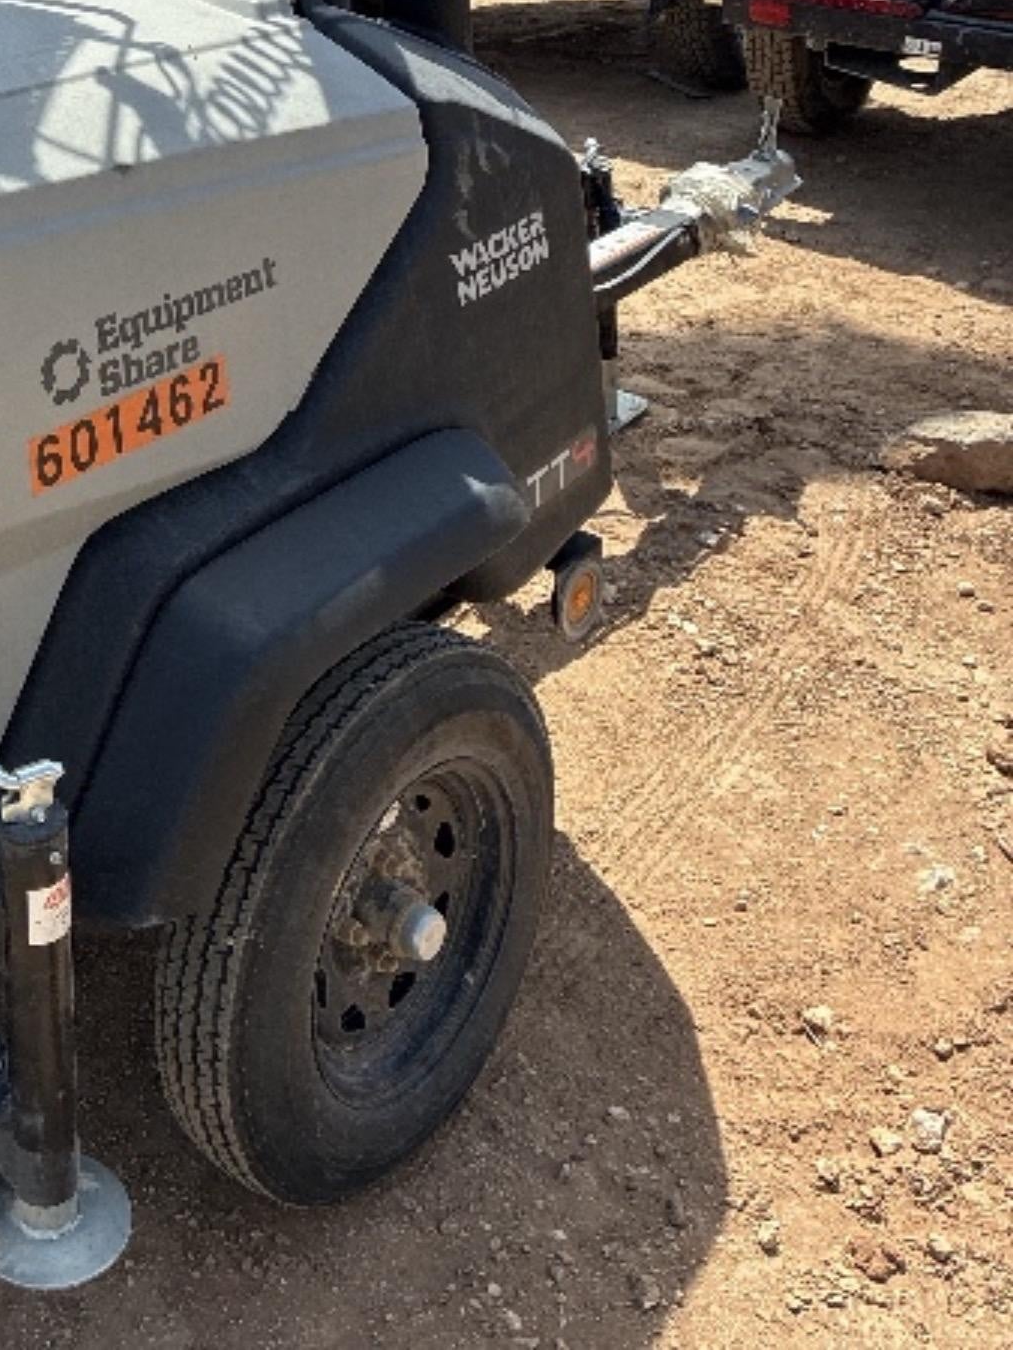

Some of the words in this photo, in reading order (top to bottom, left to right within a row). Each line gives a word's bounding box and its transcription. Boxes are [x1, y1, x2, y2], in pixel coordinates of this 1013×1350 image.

[449, 211, 546, 277] WACKER
[457, 236, 550, 307] NEUSON
[94, 256, 278, 354] Equipment
[98, 334, 202, 397] Share
[35, 361, 226, 488] 601462
